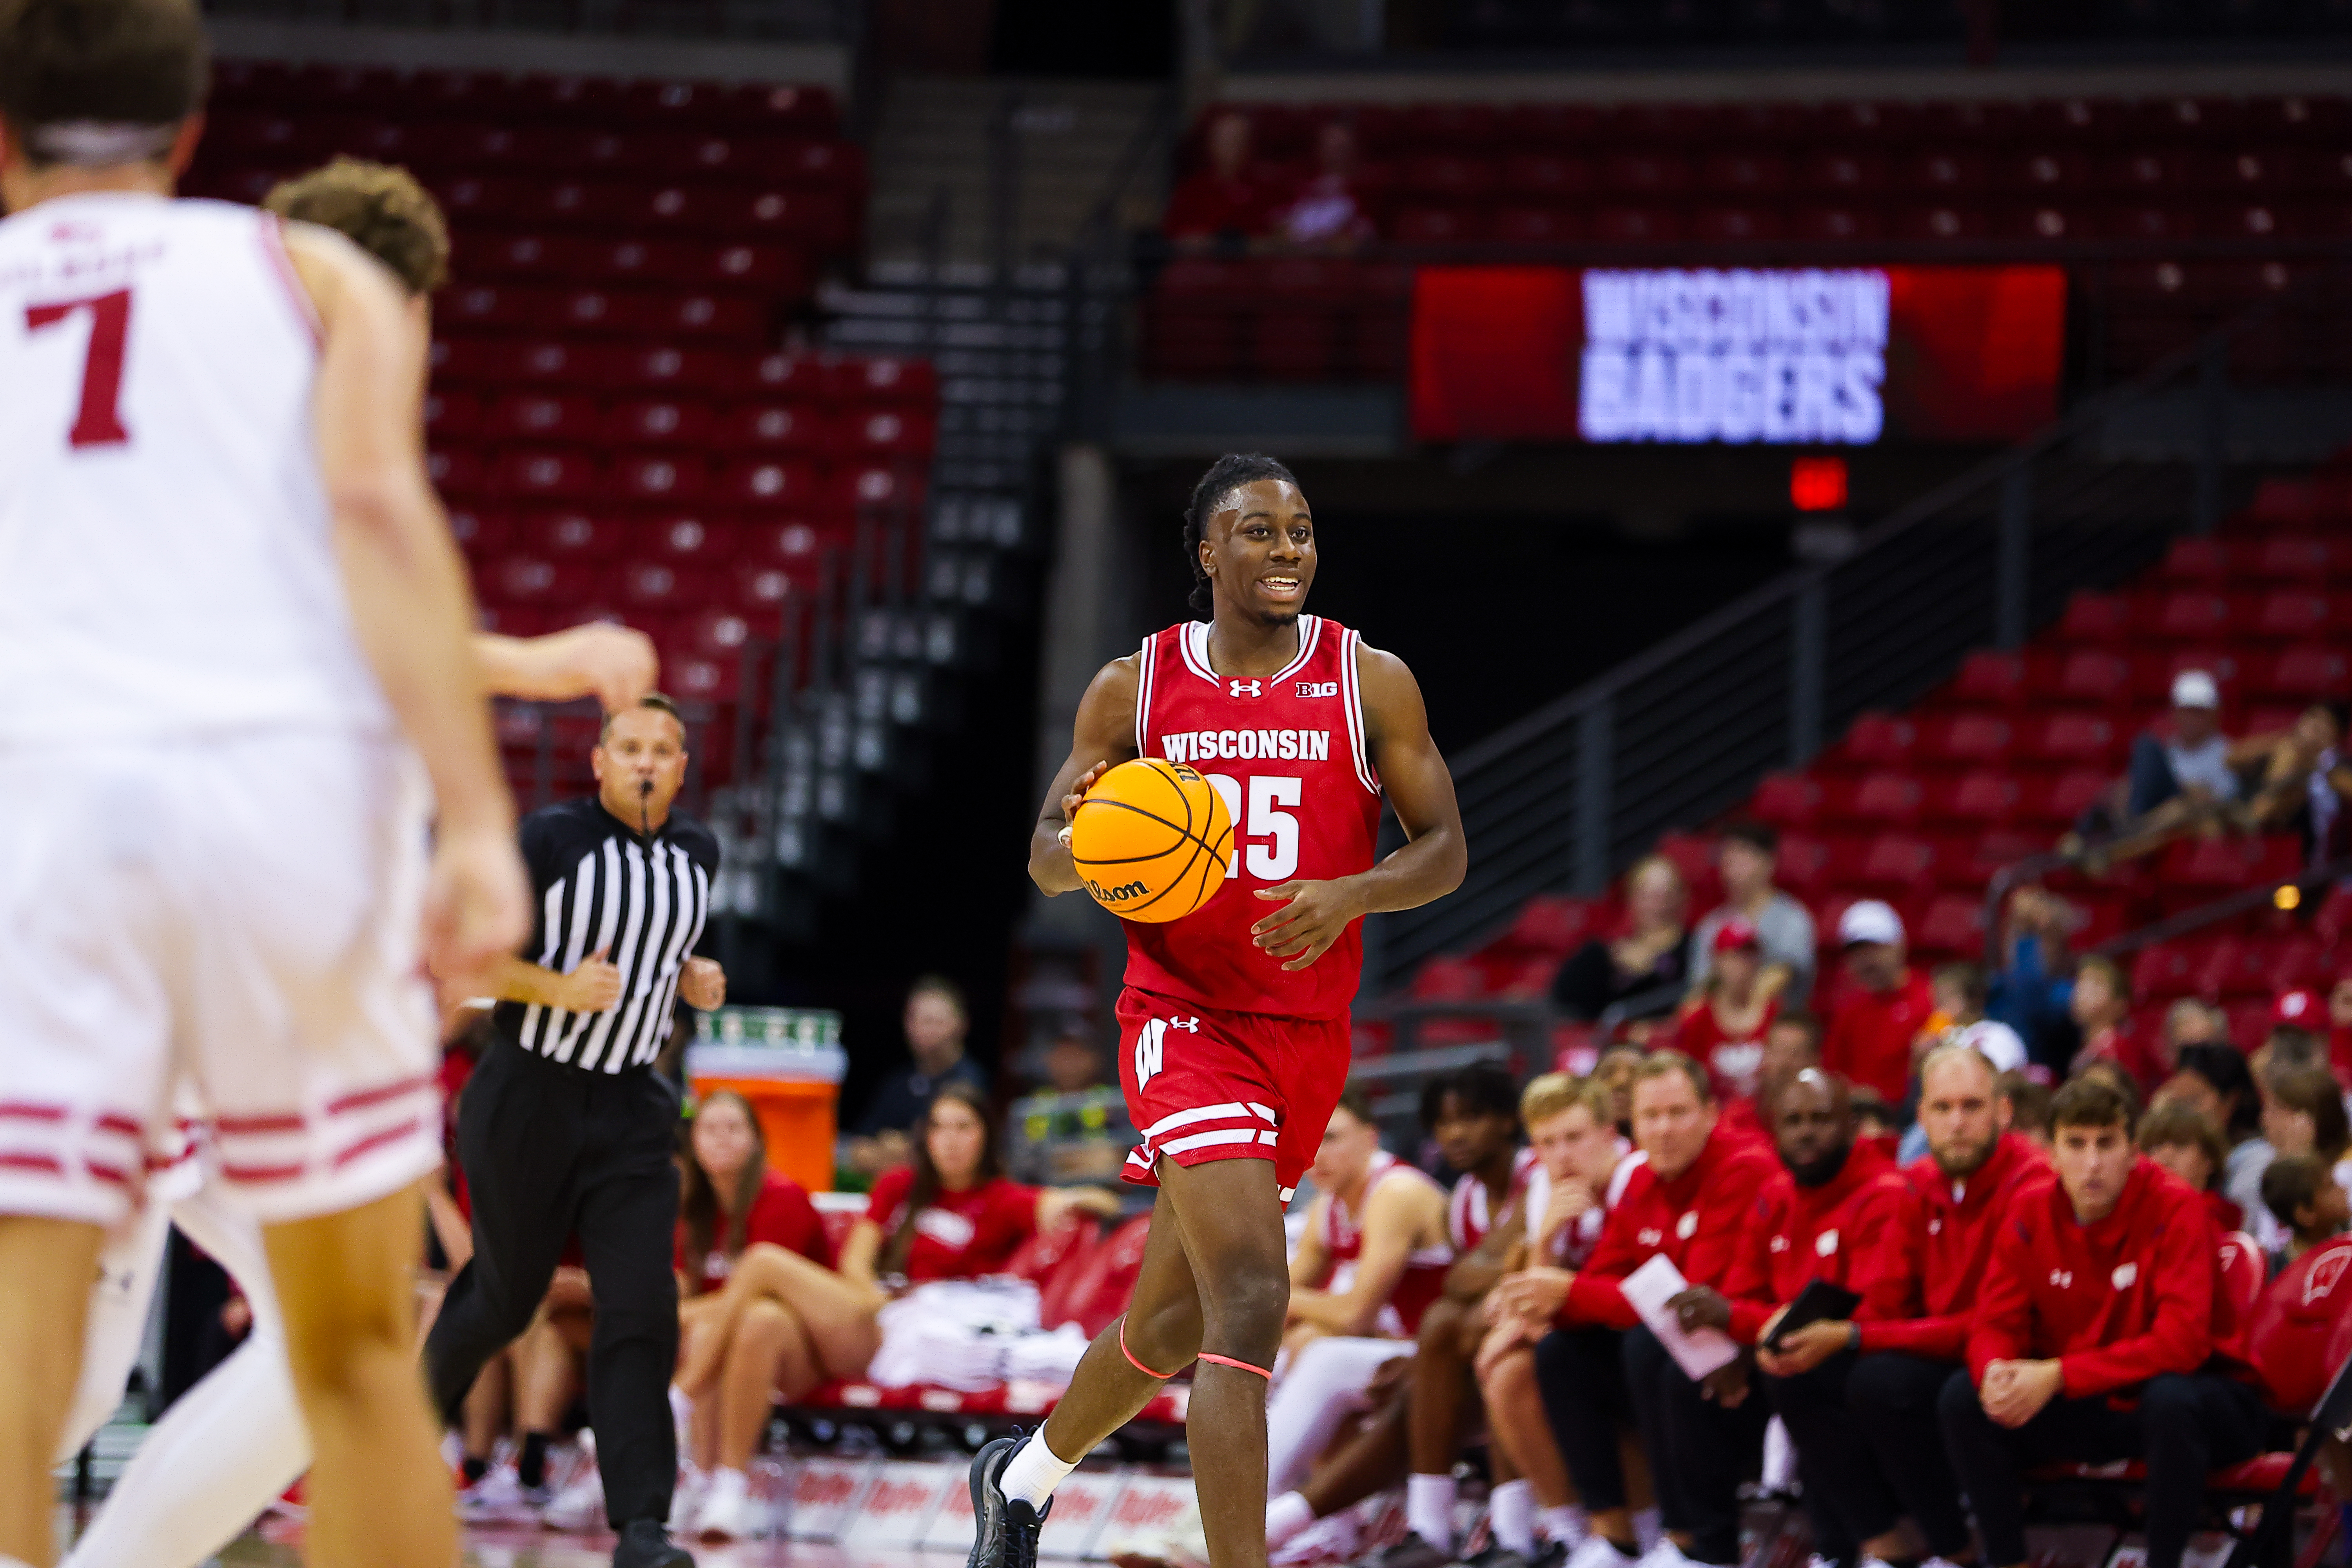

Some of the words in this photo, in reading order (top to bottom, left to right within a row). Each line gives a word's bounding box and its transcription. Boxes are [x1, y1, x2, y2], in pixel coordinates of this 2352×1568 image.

[1583, 269, 1890, 344] WISCONSIN
[26, 288, 129, 447] 7
[1578, 350, 1885, 443] BADGERS
[1161, 730, 1330, 764] WISCONSIN
[1081, 880, 1151, 902] lson
